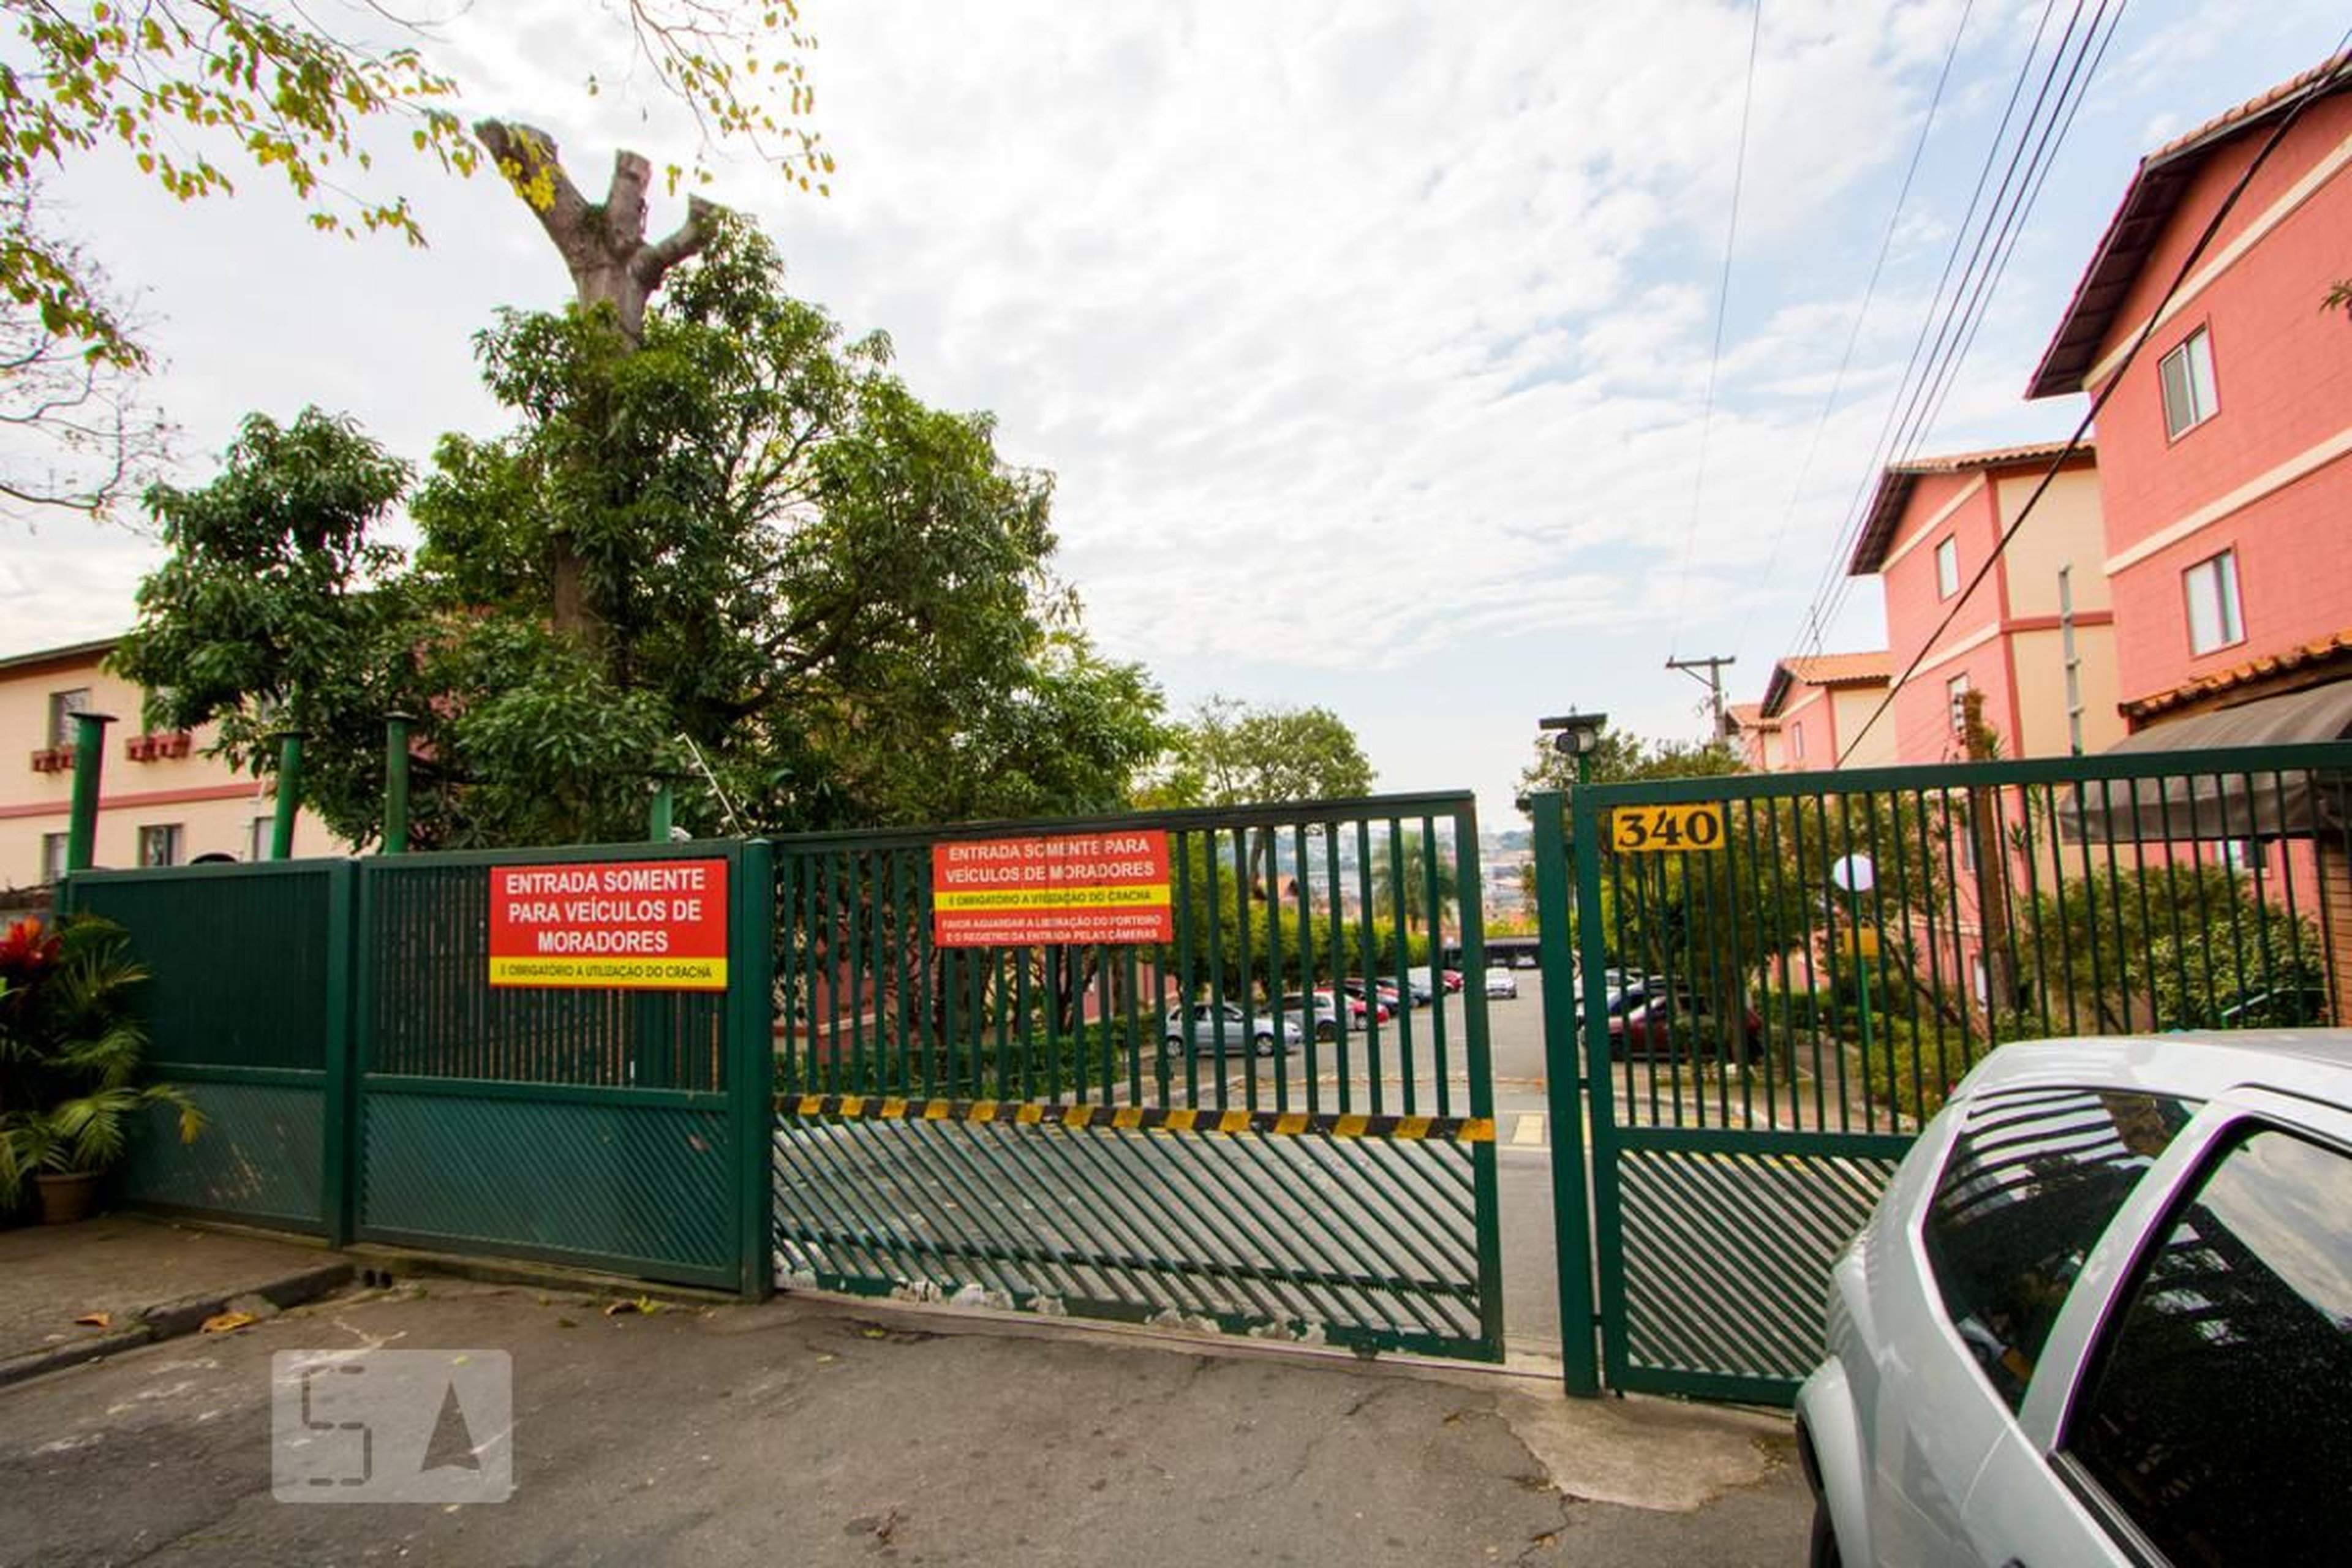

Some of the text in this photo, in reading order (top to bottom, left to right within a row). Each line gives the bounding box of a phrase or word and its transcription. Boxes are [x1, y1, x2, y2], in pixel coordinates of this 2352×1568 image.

[1619, 809, 1717, 847] 340
[949, 838, 1150, 861] ENTRADA SOMENTE PARA
[507, 869, 705, 895] ENTRADA SOMENTE
[945, 861, 1155, 883] VEÍCULOS DE MORADORES
[508, 895, 702, 923] PARA VEÍCULOS DE
[1022, 895, 1030, 905] A
[1089, 892, 1105, 902] DO
[1027, 918, 1034, 928] A
[1093, 916, 1109, 926] DO
[1110, 914, 1162, 925] PORTEIRO
[538, 930, 668, 952] MORADORES
[1074, 930, 1106, 940] PELAS
[1108, 928, 1158, 940] CÂMERAS
[576, 965, 584, 977] A
[646, 965, 663, 978] DO
